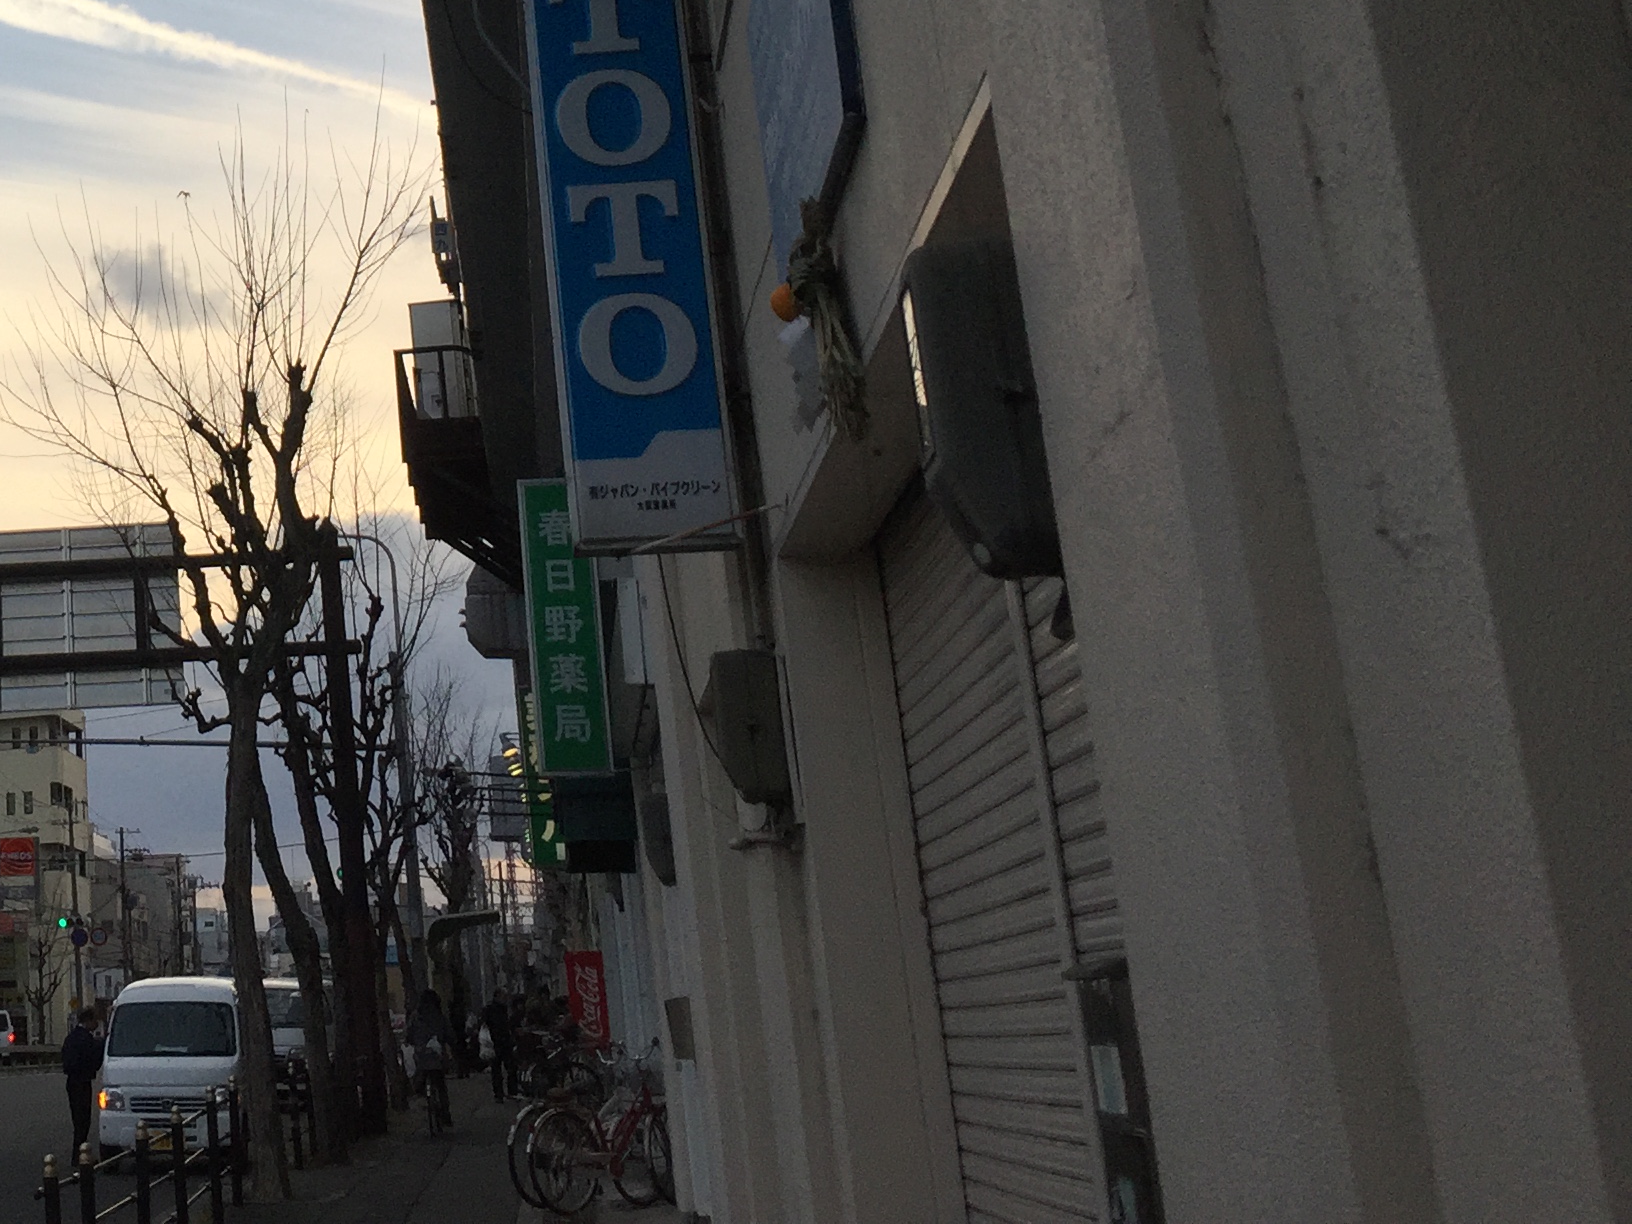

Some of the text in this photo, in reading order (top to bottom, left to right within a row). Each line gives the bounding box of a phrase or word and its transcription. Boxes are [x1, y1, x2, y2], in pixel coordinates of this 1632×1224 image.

[538, 510, 591, 743] 春日野薬局
